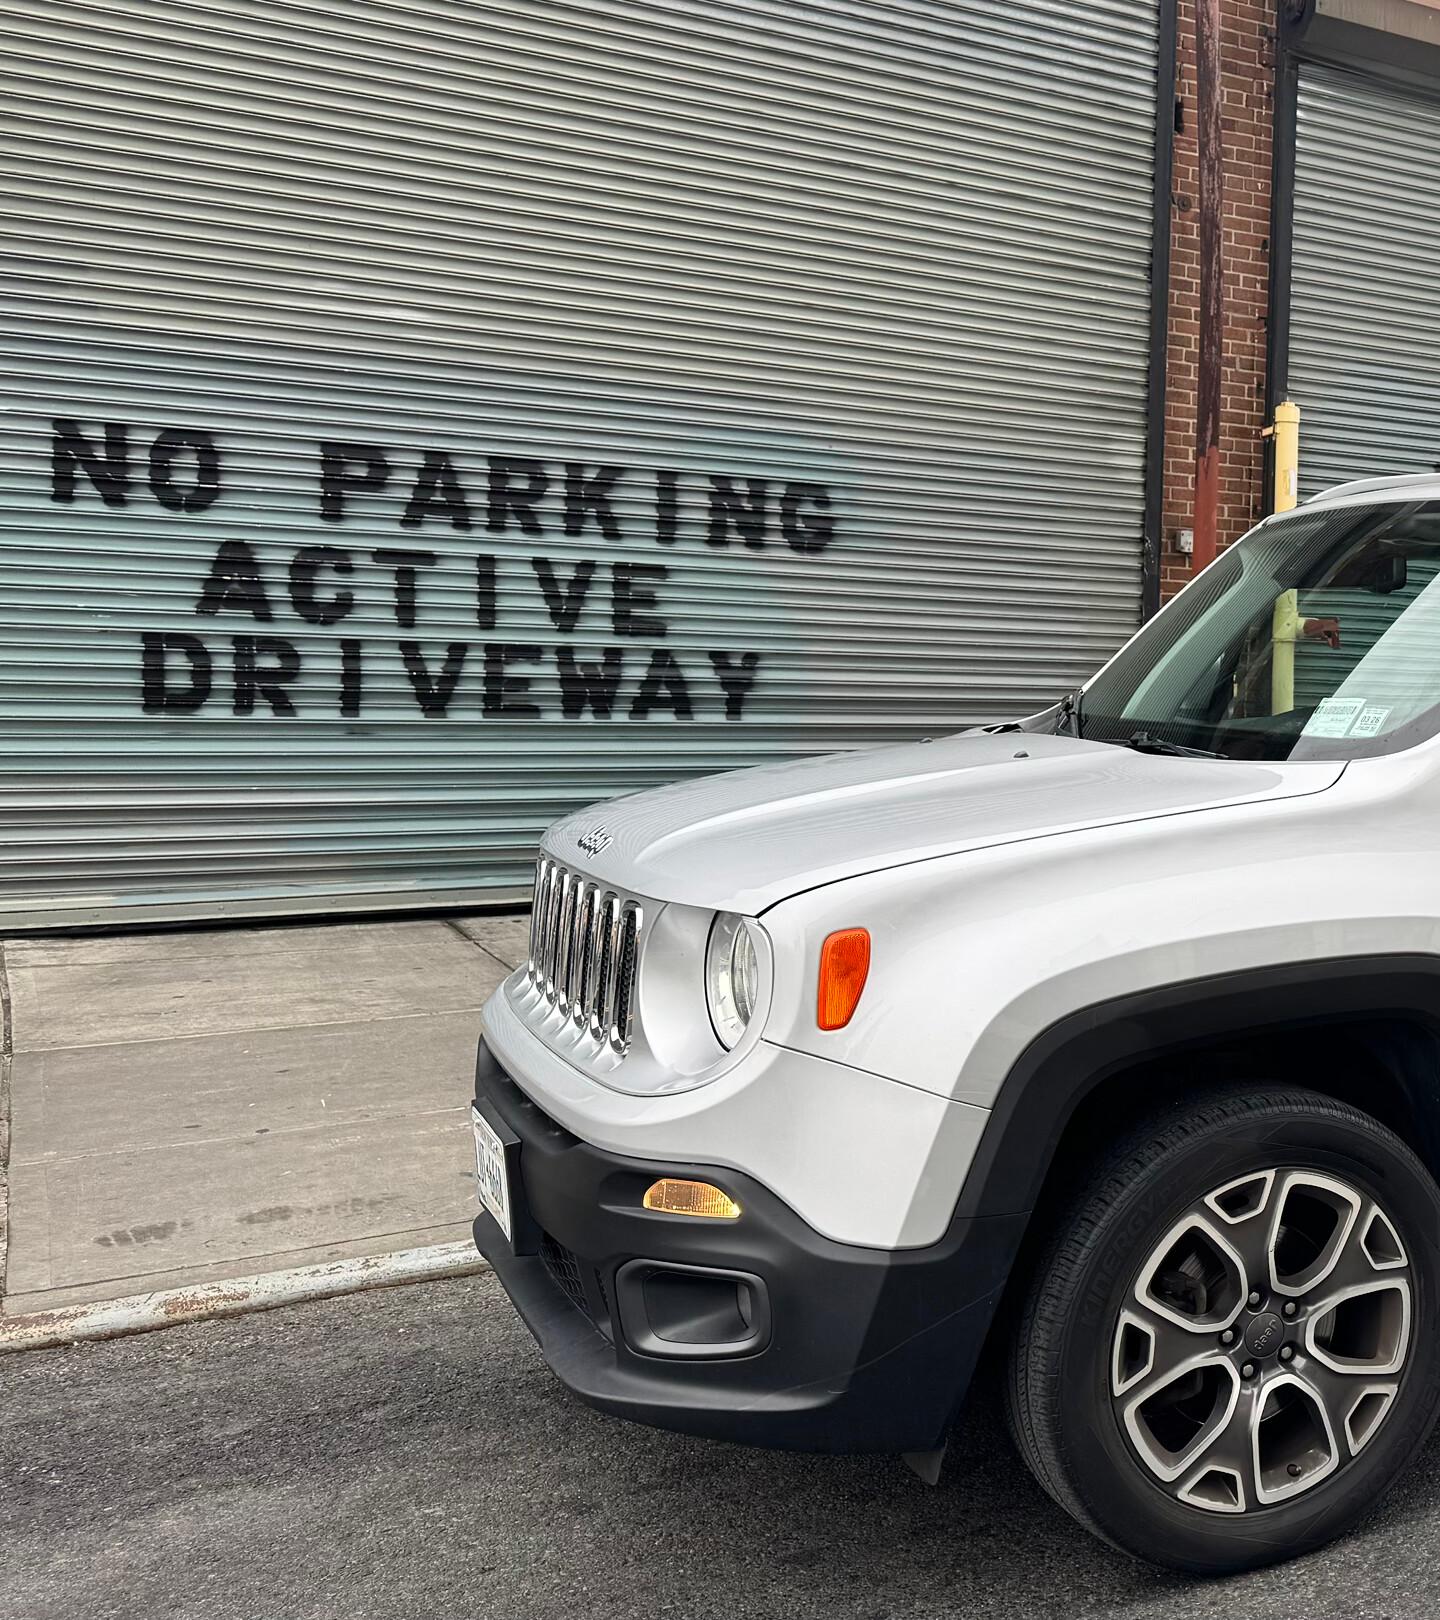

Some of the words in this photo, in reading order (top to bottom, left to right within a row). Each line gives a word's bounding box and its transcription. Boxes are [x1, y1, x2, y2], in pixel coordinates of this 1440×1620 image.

[51, 418, 222, 513] NO
[319, 440, 839, 555] PARKING
[194, 538, 669, 638] ACTIVE
[141, 632, 760, 721] DRIVEWAY
[577, 825, 614, 860] Jeep
